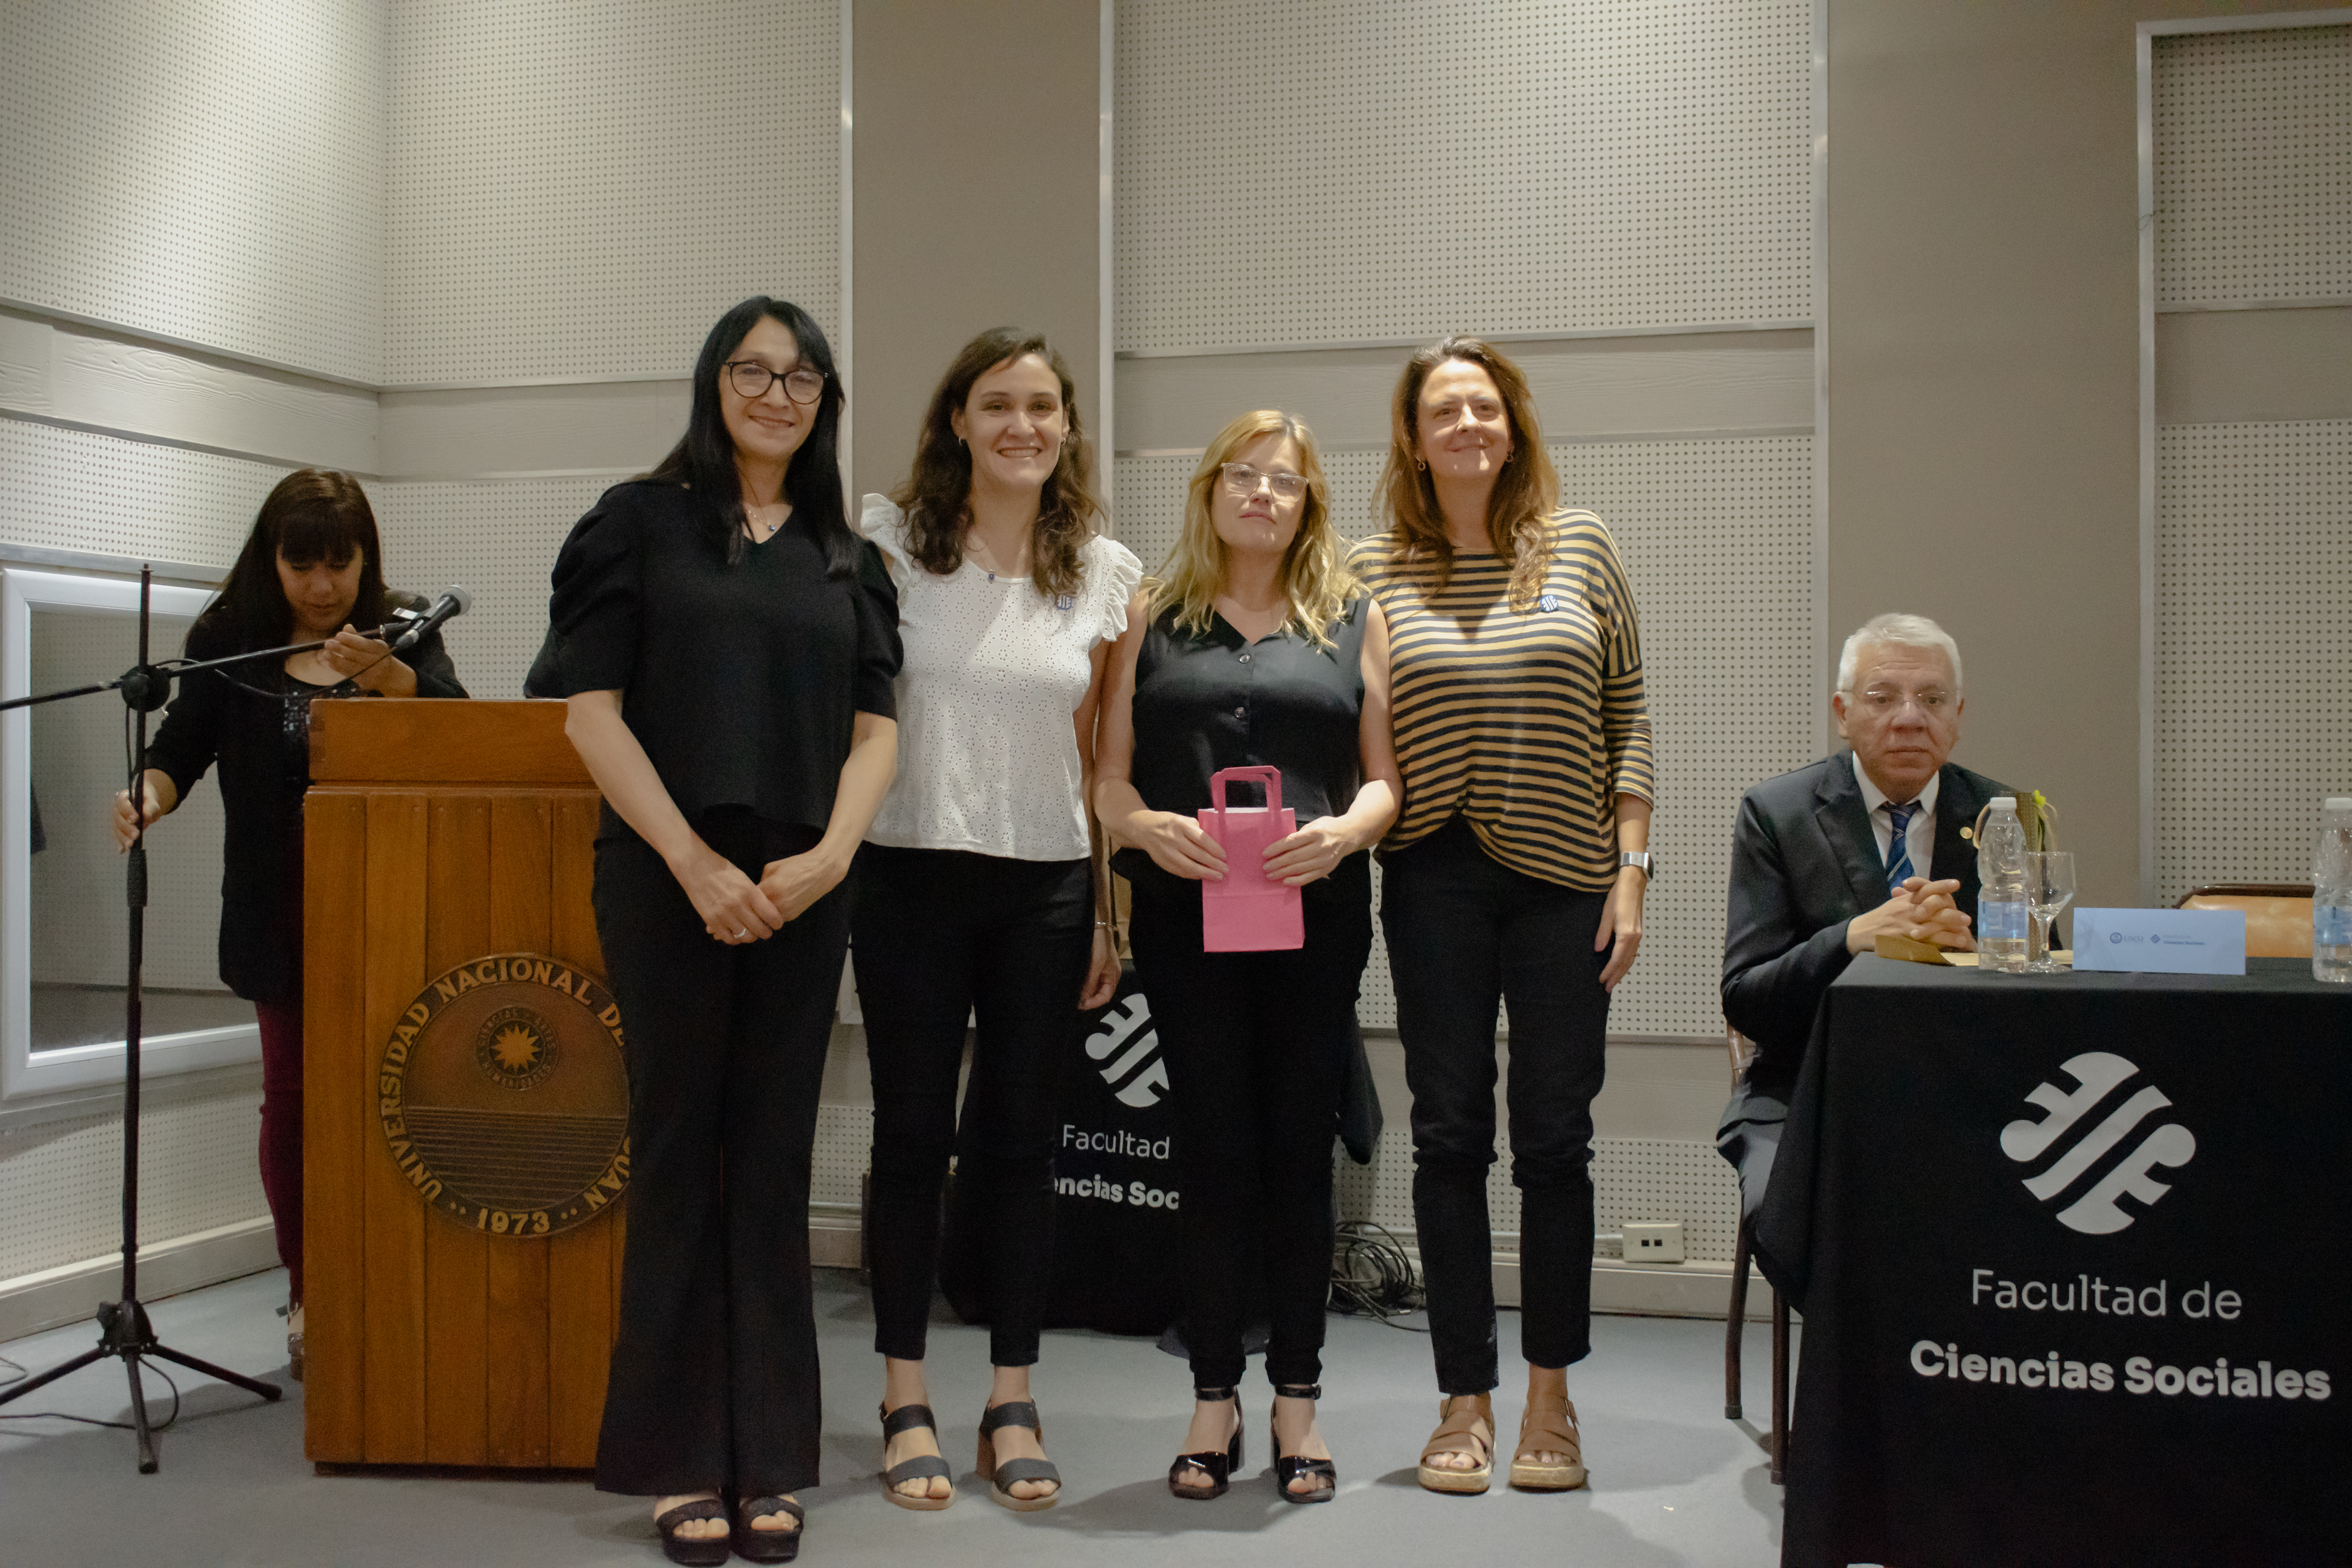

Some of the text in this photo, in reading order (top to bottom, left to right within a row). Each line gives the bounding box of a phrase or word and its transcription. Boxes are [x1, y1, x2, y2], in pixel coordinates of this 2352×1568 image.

[380, 1003, 442, 1203] UNIVERSIDAD
[435, 958, 591, 1005] NACIONAL
[1063, 1124, 1170, 1160] Facultad
[477, 1208, 550, 1234] 1973
[1972, 1268, 2242, 1319] Facultad de
[1910, 1340, 2332, 1401] Ciencias Sociales
